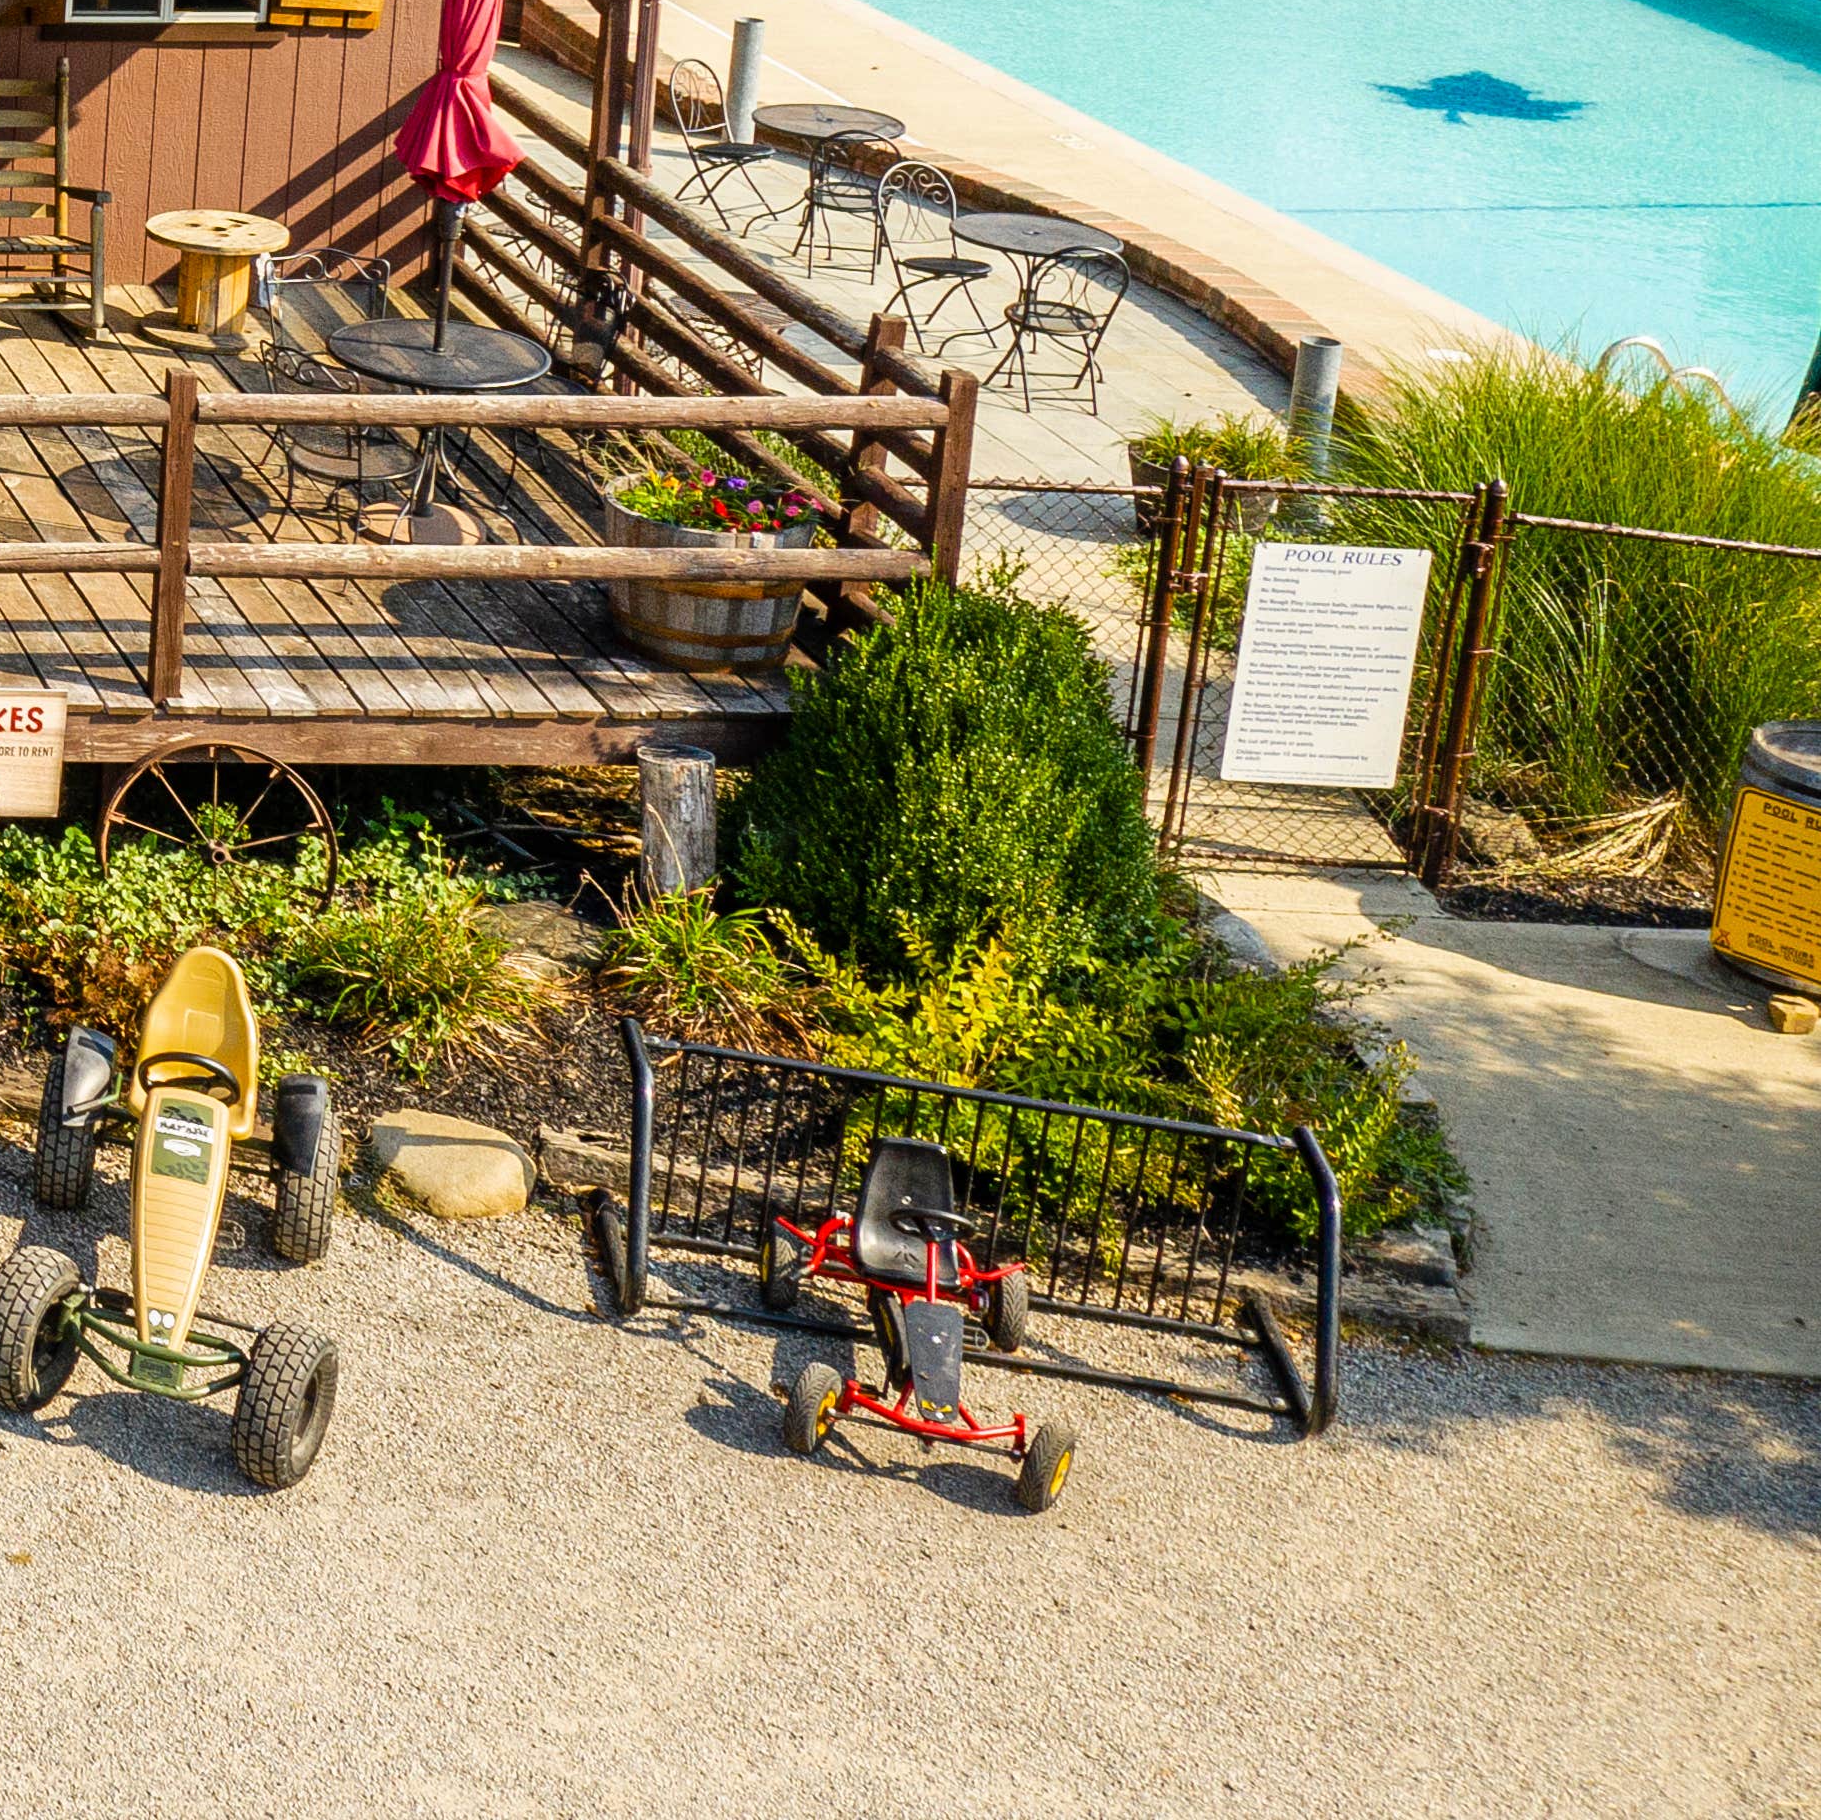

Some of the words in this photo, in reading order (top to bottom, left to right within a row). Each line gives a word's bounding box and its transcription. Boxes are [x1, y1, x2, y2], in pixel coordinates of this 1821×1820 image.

[1284, 548, 1337, 564] POOL
[1342, 551, 1404, 567] RULES
[17, 746, 29, 757] TO
[31, 746, 55, 757] RENT
[1763, 802, 1798, 824] POOL
